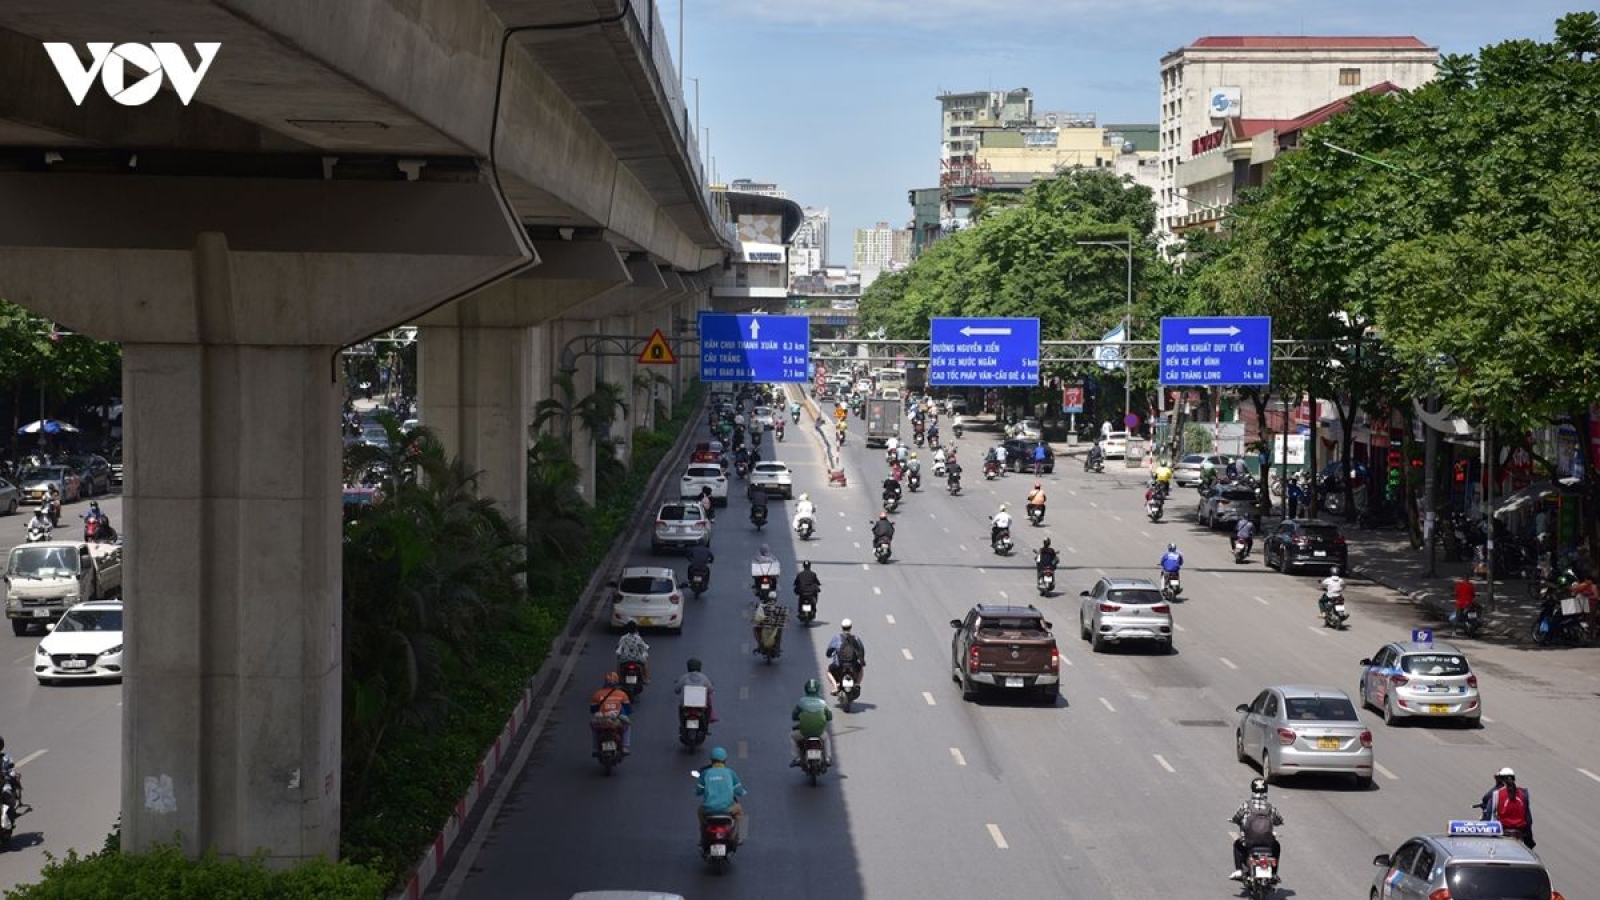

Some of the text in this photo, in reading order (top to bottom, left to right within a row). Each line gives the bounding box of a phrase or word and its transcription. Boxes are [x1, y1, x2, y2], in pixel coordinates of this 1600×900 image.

[738, 340, 758, 350] THANH
[760, 339, 778, 350] XUÂN
[794, 342, 805, 350] km
[933, 342, 955, 353] ĐƯỜNG
[1166, 341, 1245, 353] ĐƯỜNG KHUẤT DUY TIẾN
[794, 355, 805, 364] km
[932, 355, 945, 366] BẾN
[947, 358, 956, 366] XE
[958, 356, 976, 366] NƯỚC
[1022, 358, 1027, 367] 5
[1027, 358, 1038, 367] km
[1166, 355, 1179, 366] BẾN
[1181, 357, 1189, 366] XE
[1191, 355, 1202, 366] MỸ
[1247, 357, 1252, 366] 6
[1253, 357, 1265, 366] km
[794, 368, 805, 377] km
[932, 371, 945, 380] CAO
[946, 369, 959, 380] TỐC
[960, 370, 977, 380] PHÁP
[1021, 371, 1026, 380] 6
[1027, 371, 1038, 380] km
[1166, 369, 1264, 380] CẦU THĂNG LONG 14 km
